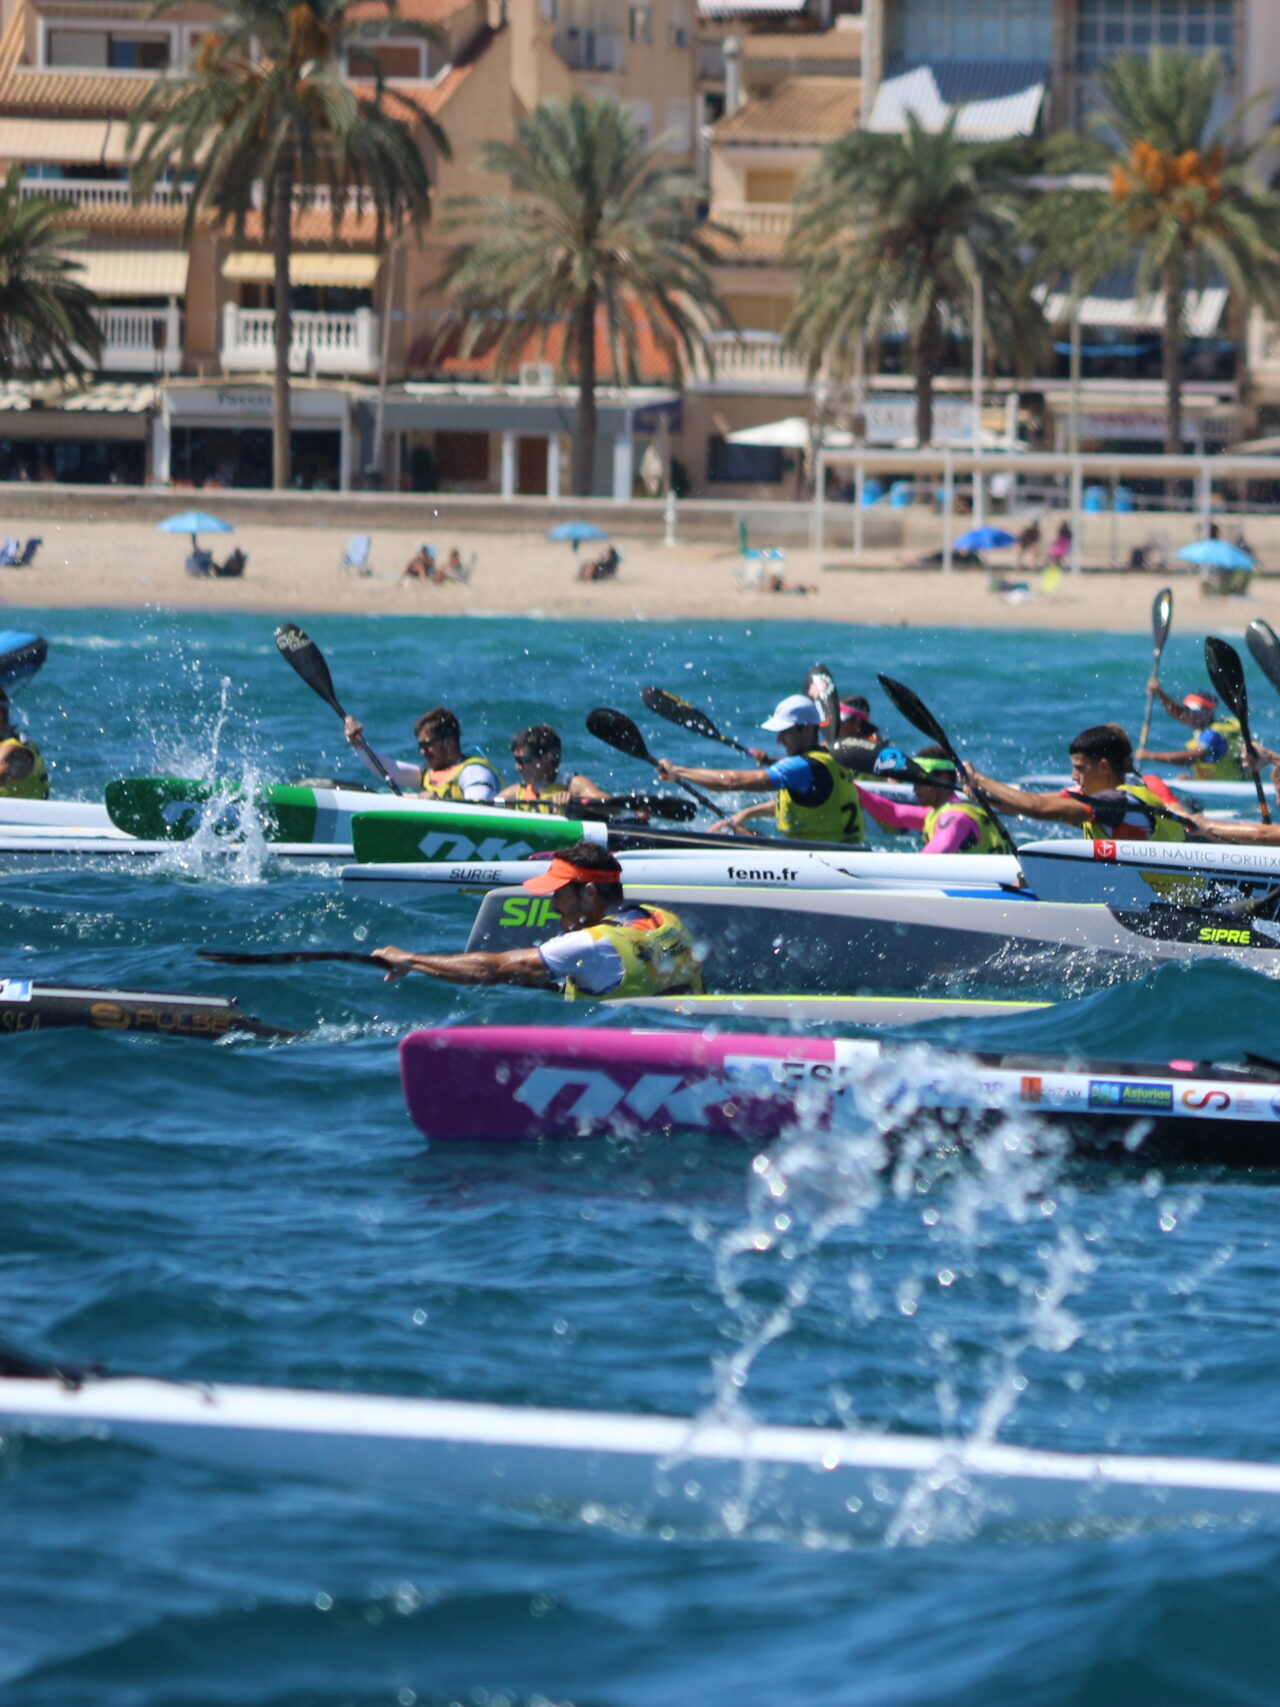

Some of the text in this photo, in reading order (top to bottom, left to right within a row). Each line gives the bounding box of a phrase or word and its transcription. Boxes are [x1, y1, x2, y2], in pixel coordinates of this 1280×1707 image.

[1120, 844, 1158, 858] CLUB
[450, 868, 502, 881] SURGE
[727, 866, 798, 881] fenn.fr
[1198, 928, 1251, 945] SIPRE
